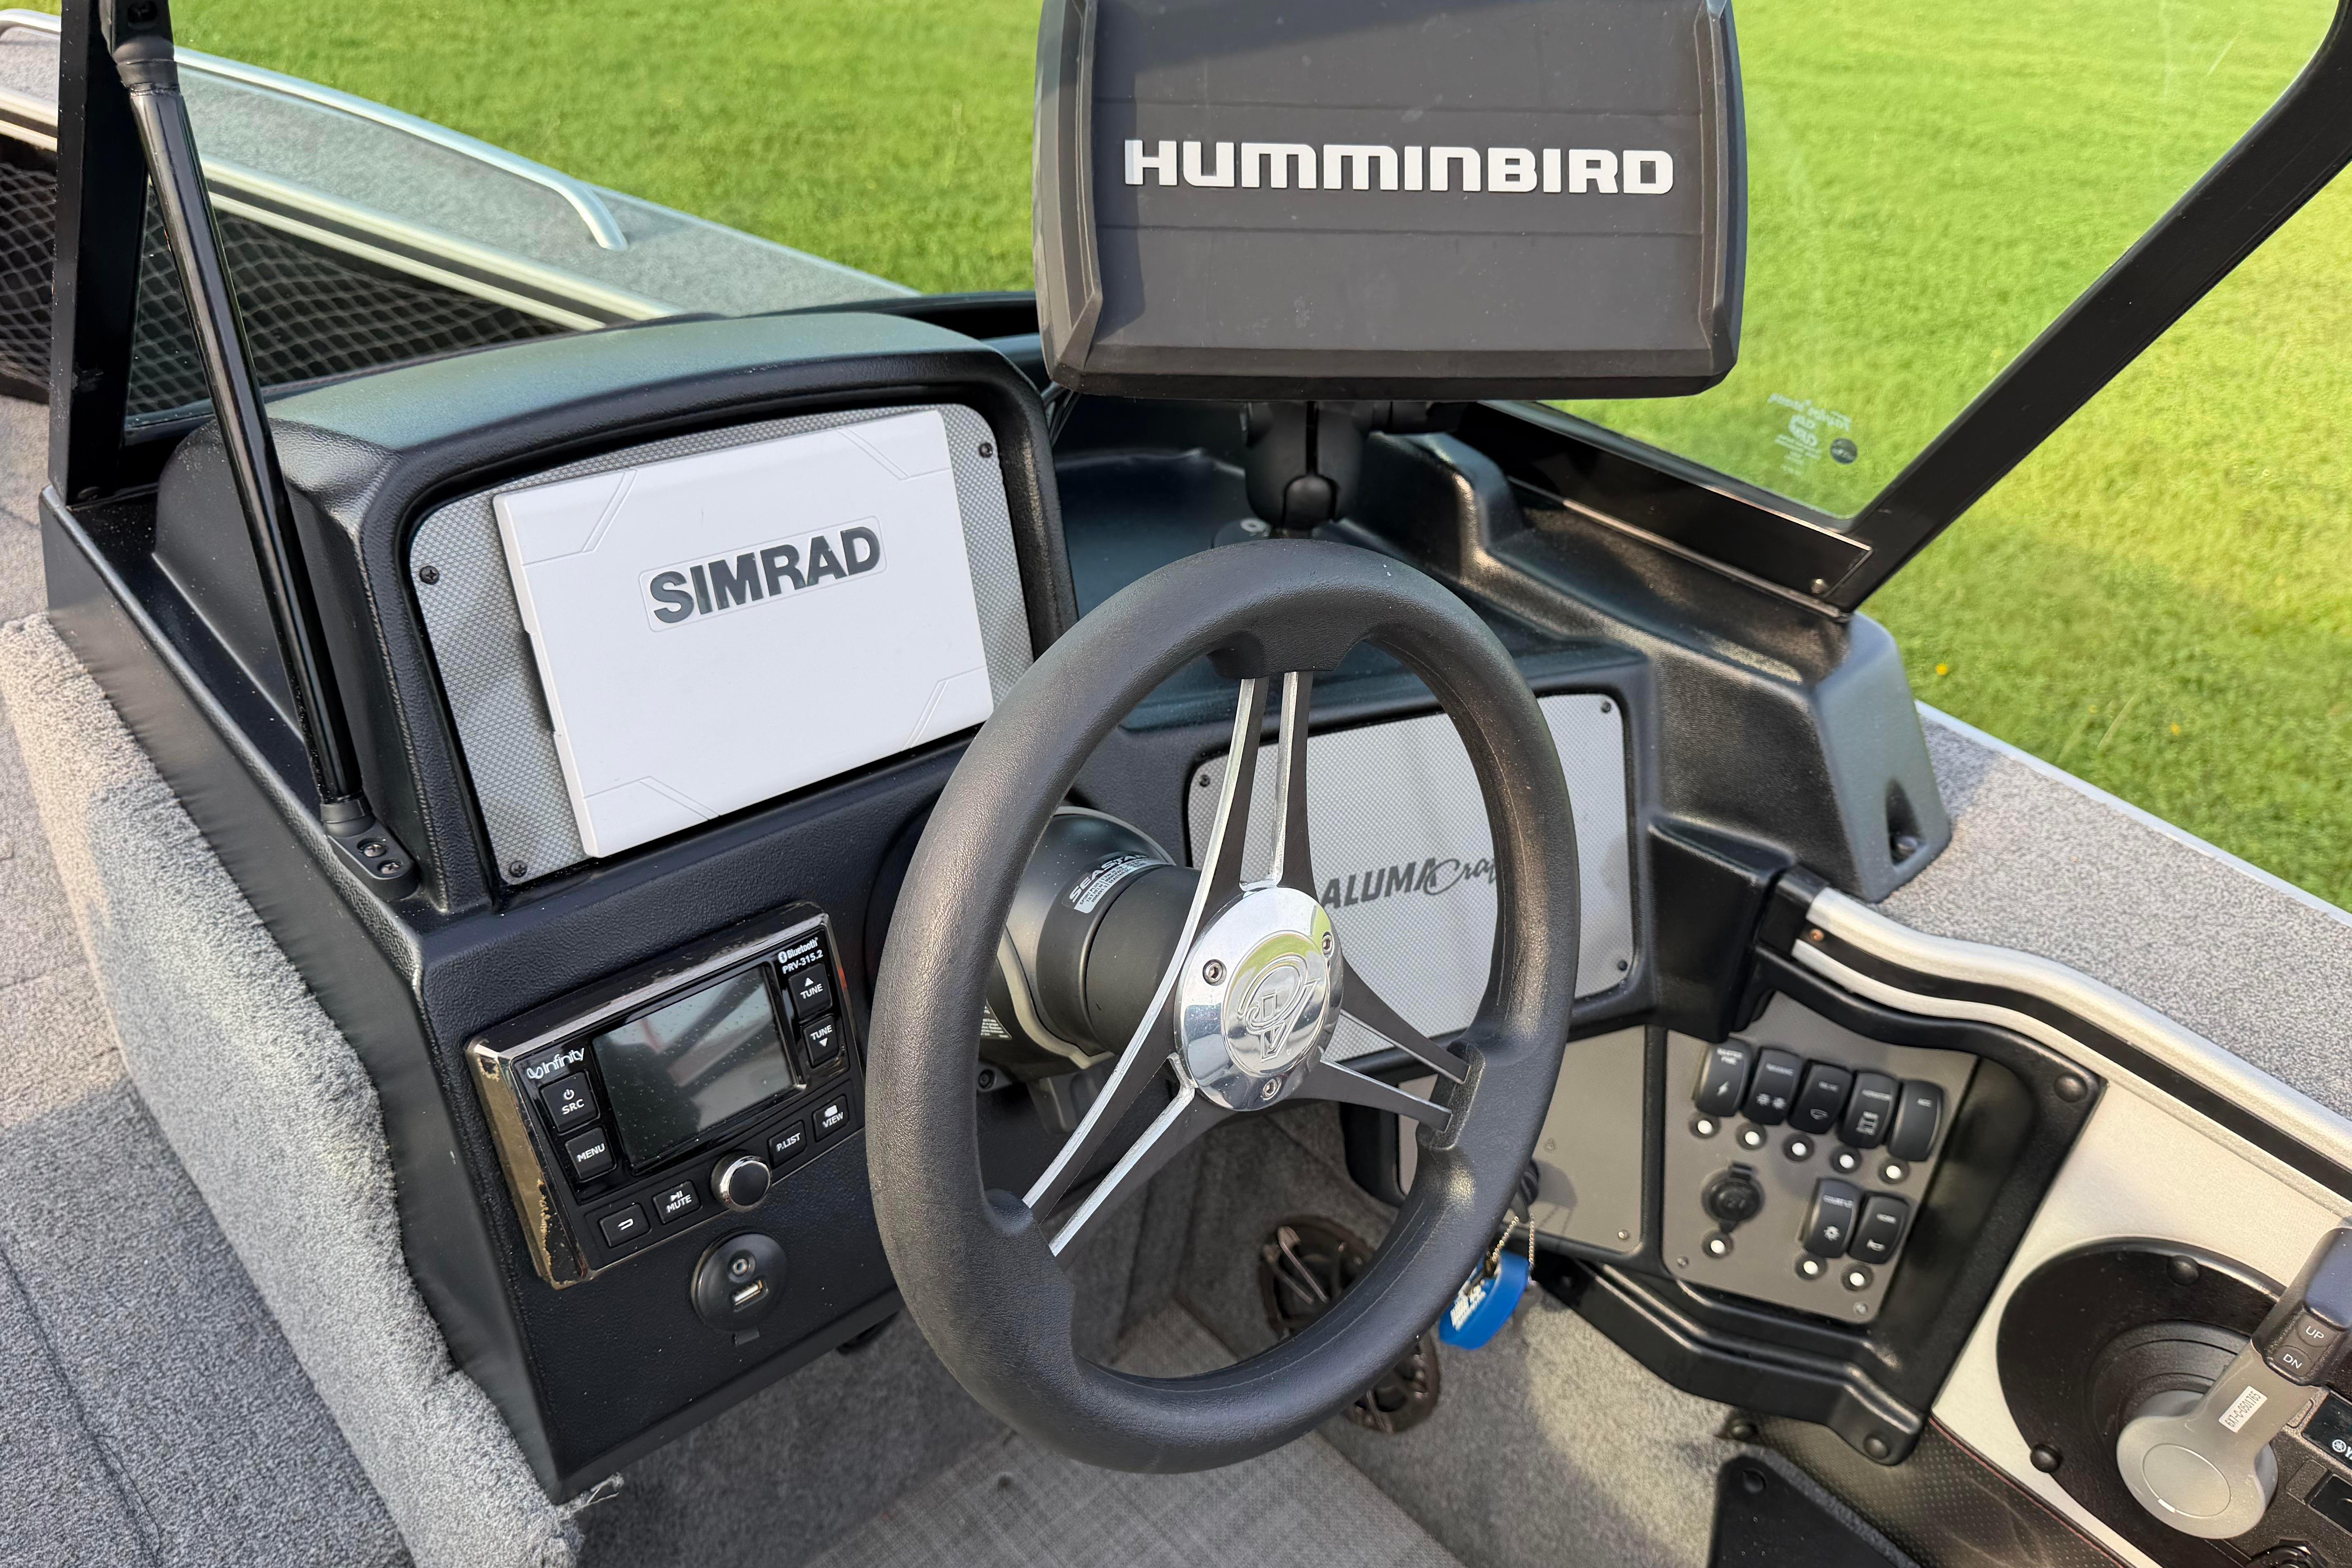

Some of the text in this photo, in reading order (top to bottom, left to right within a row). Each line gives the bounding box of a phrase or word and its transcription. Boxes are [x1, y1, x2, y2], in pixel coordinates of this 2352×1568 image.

[1124, 139, 1674, 194] HUMMINBIRD
[649, 525, 881, 624] SIMRAD
[1069, 855, 1147, 903] SEASTAR
[787, 938, 818, 959] Bluetooth
[782, 949, 824, 975] PRV-315.2
[800, 983, 823, 999] TUNE
[810, 1024, 833, 1041] TUNE
[542, 1048, 584, 1074] Infinity
[562, 1099, 584, 1115] SRC
[822, 1112, 843, 1128] VIEW
[776, 1132, 800, 1152] P.LIST
[577, 1143, 605, 1162] MENU
[666, 1194, 692, 1213] MUTE
[2306, 1325, 2324, 1339] UP
[2283, 1353, 2303, 1369] DN
